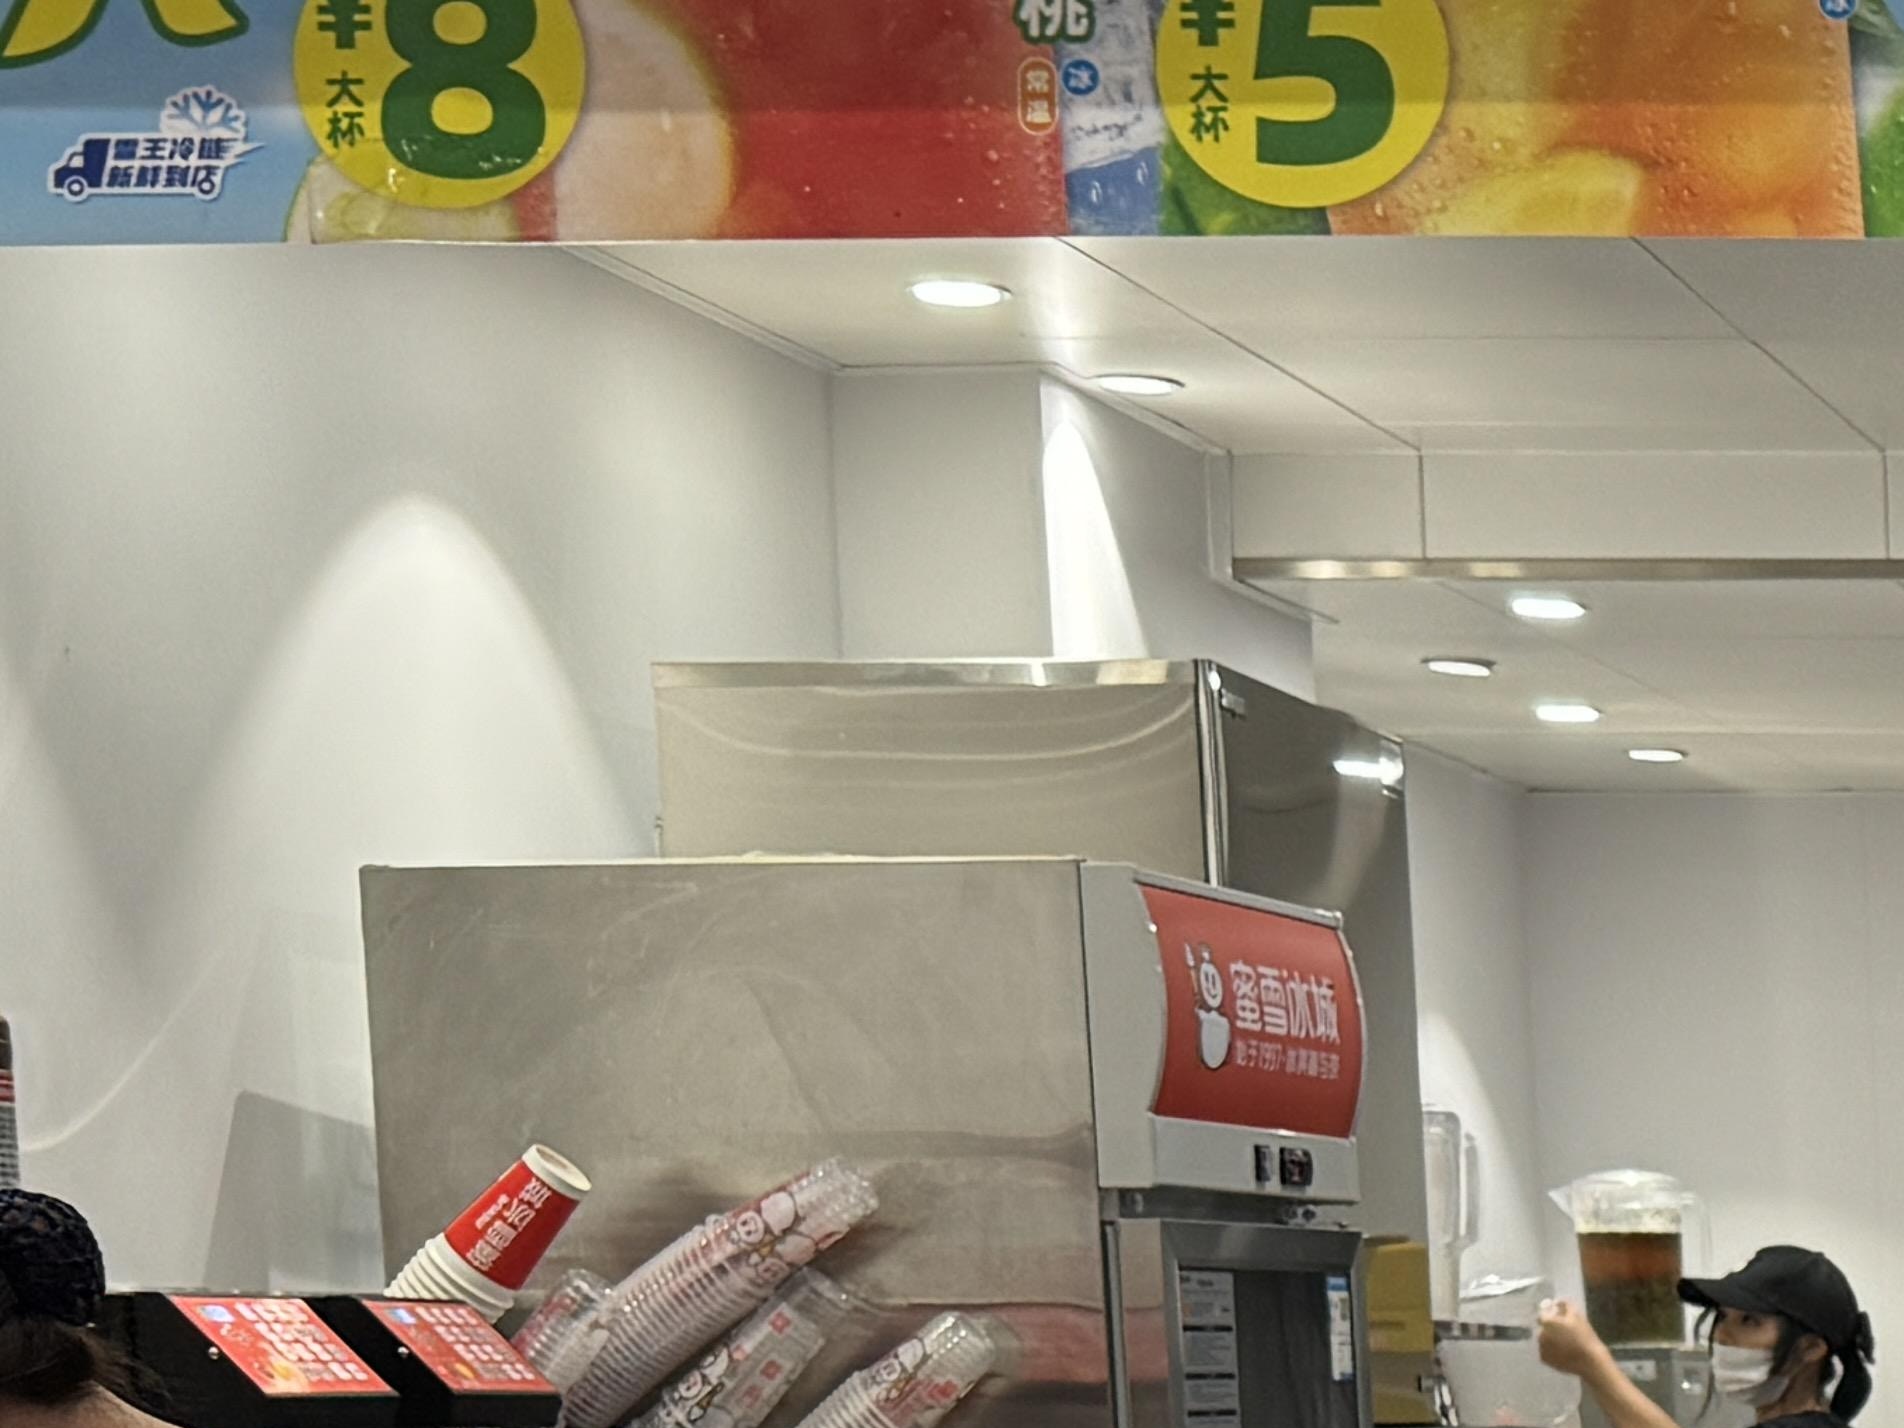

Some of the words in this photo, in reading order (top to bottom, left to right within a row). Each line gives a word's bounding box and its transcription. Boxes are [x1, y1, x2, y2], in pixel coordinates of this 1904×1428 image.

[325, 71, 365, 148] 大杯
[1189, 65, 1230, 143] 大杯
[1229, 960, 1341, 1045] 蜜雪冰城
